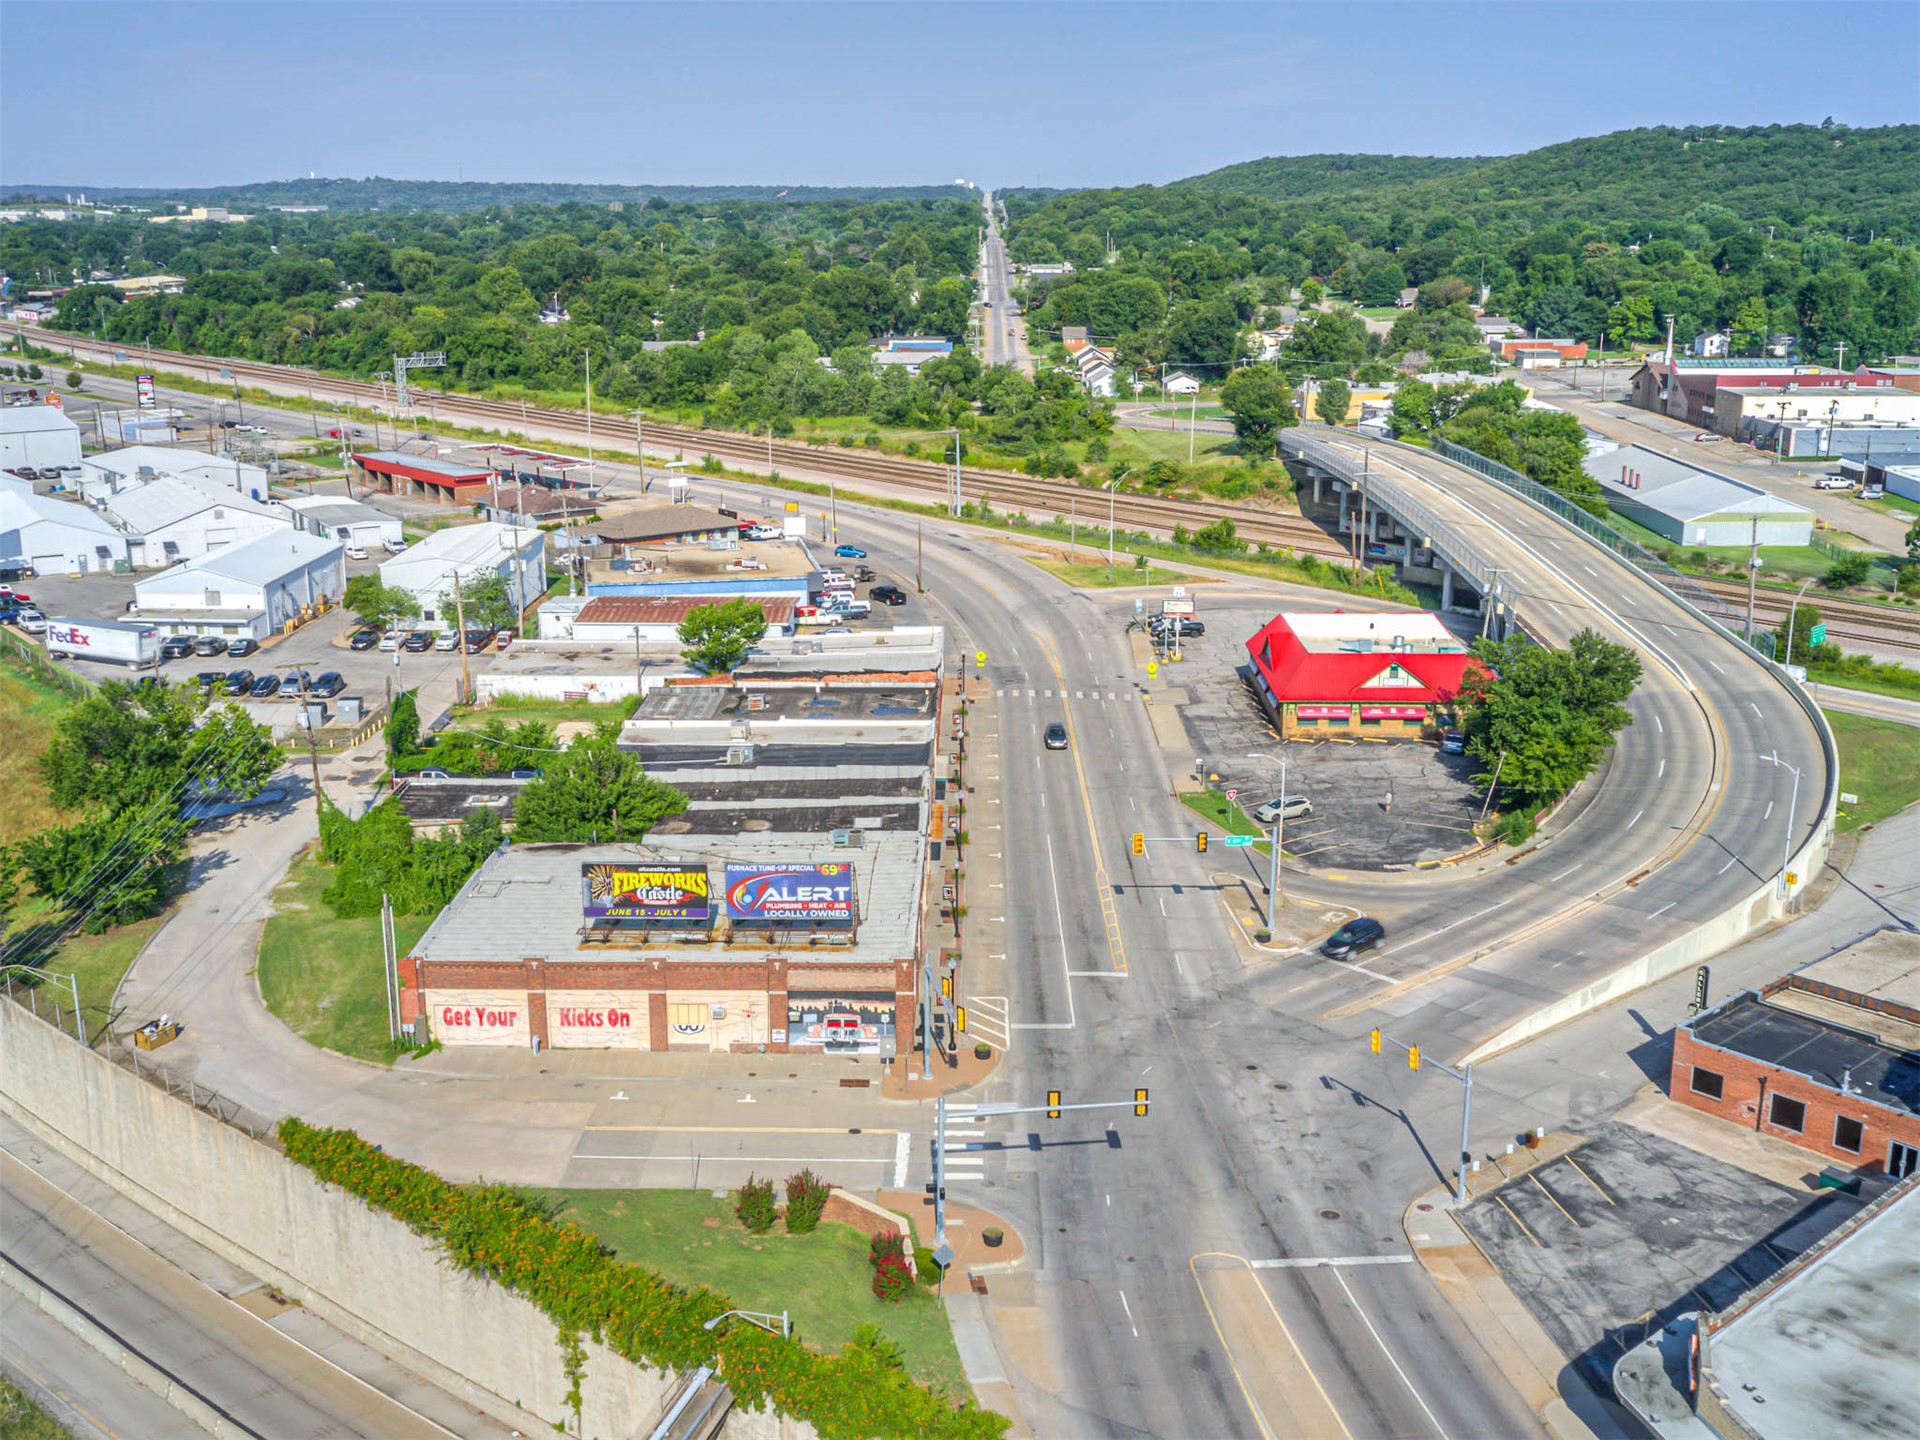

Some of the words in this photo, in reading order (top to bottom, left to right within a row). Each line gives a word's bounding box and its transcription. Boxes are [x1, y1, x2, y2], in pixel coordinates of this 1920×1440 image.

[49, 625, 90, 646] FedEx
[613, 872, 707, 897] FIREWORKS
[636, 884, 683, 901] Castle
[757, 886, 850, 903] ALERT
[1696, 970, 1704, 1008] GALLERY
[442, 1007, 472, 1027] Get
[474, 1007, 517, 1027] Your
[559, 1008, 604, 1028] Kicks
[607, 1008, 630, 1028] On
